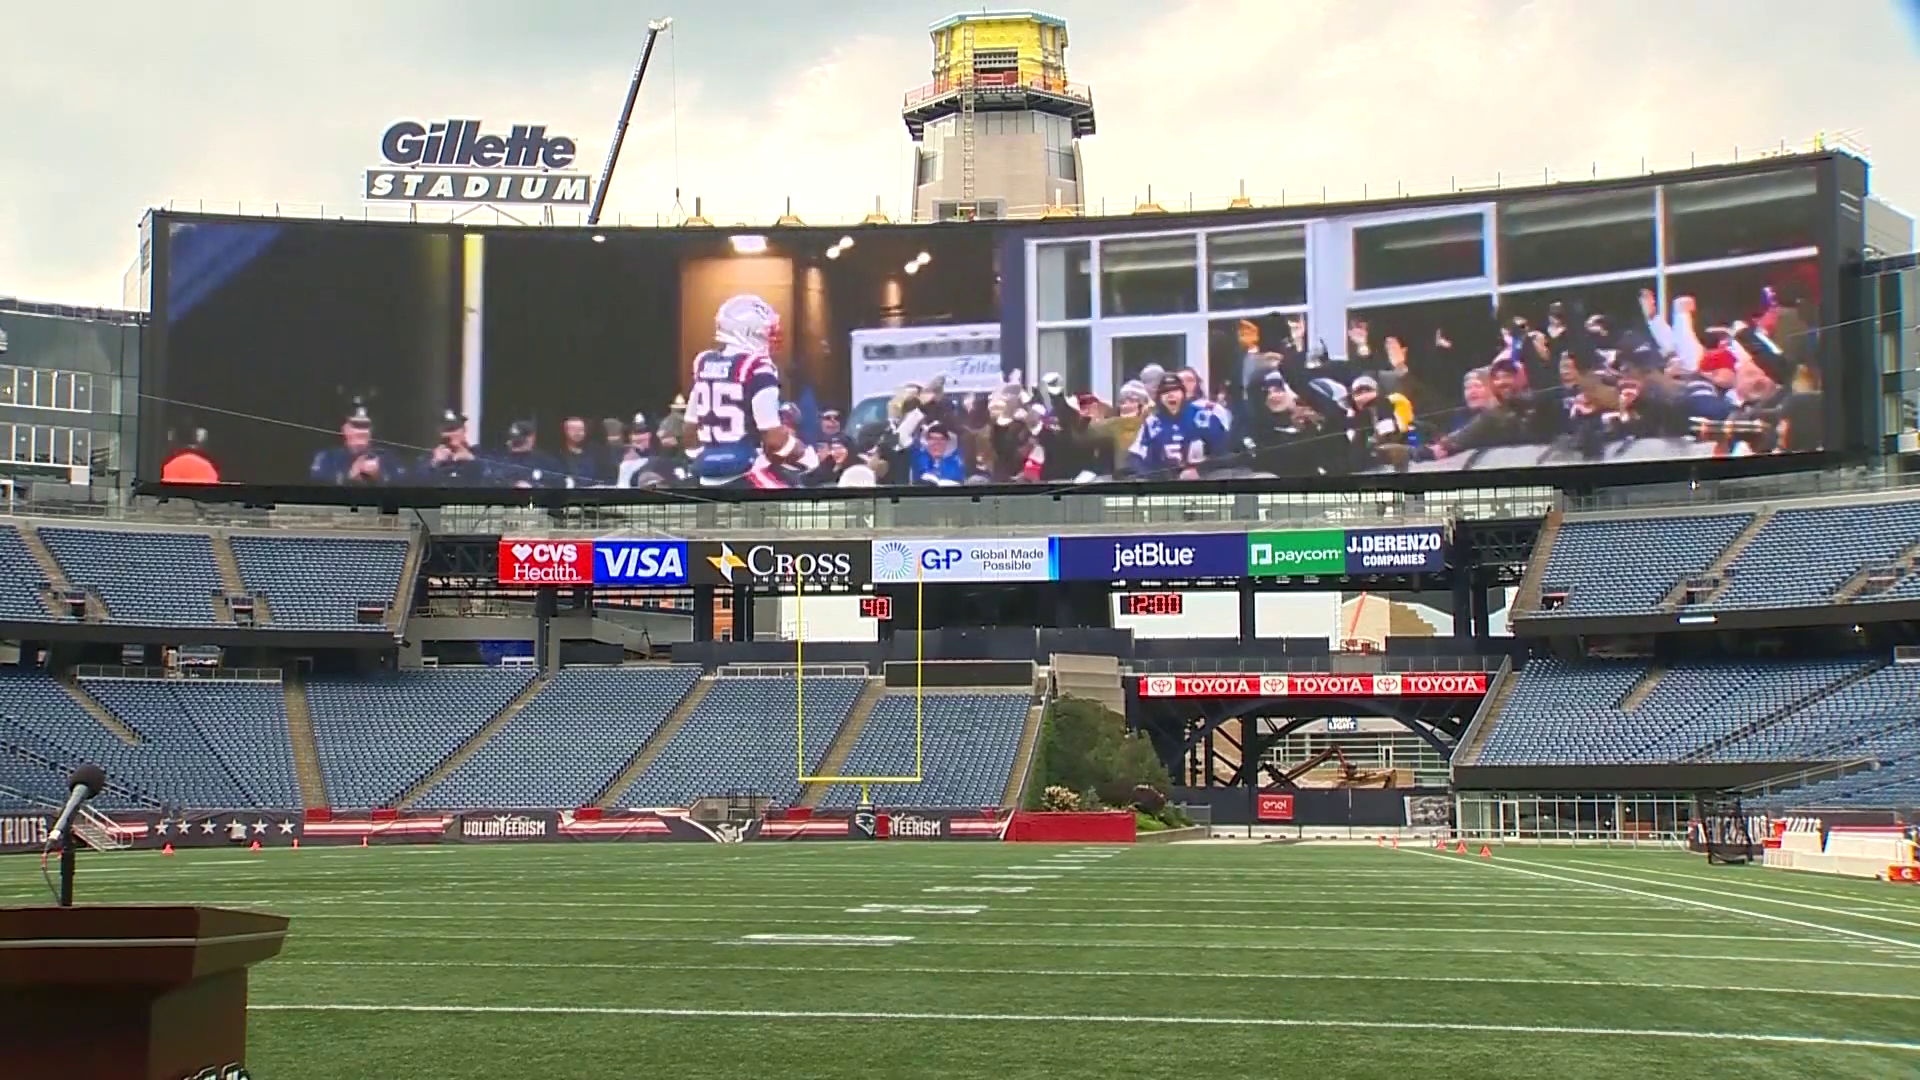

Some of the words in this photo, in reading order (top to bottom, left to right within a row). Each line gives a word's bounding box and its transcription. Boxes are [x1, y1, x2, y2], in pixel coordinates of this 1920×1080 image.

[381, 119, 576, 168] Gillette
[371, 174, 586, 200] STADIUM
[533, 544, 577, 562] CVS
[971, 550, 1007, 560] Global
[1011, 549, 1044, 559] Made
[1112, 542, 1194, 572] jetBlue
[1275, 549, 1338, 564] paycom
[1363, 554, 1426, 567] COMPANIES
[596, 548, 684, 577] VISA
[983, 561, 1032, 570] Possible
[513, 563, 577, 581] Health
[863, 598, 888, 617] 40
[1130, 595, 1180, 615] 12:00
[1181, 678, 1250, 693] TOYOTA
[1294, 677, 1363, 692] TOYOTA
[1408, 676, 1477, 691] TOYOTA
[1263, 800, 1287, 809] enel
